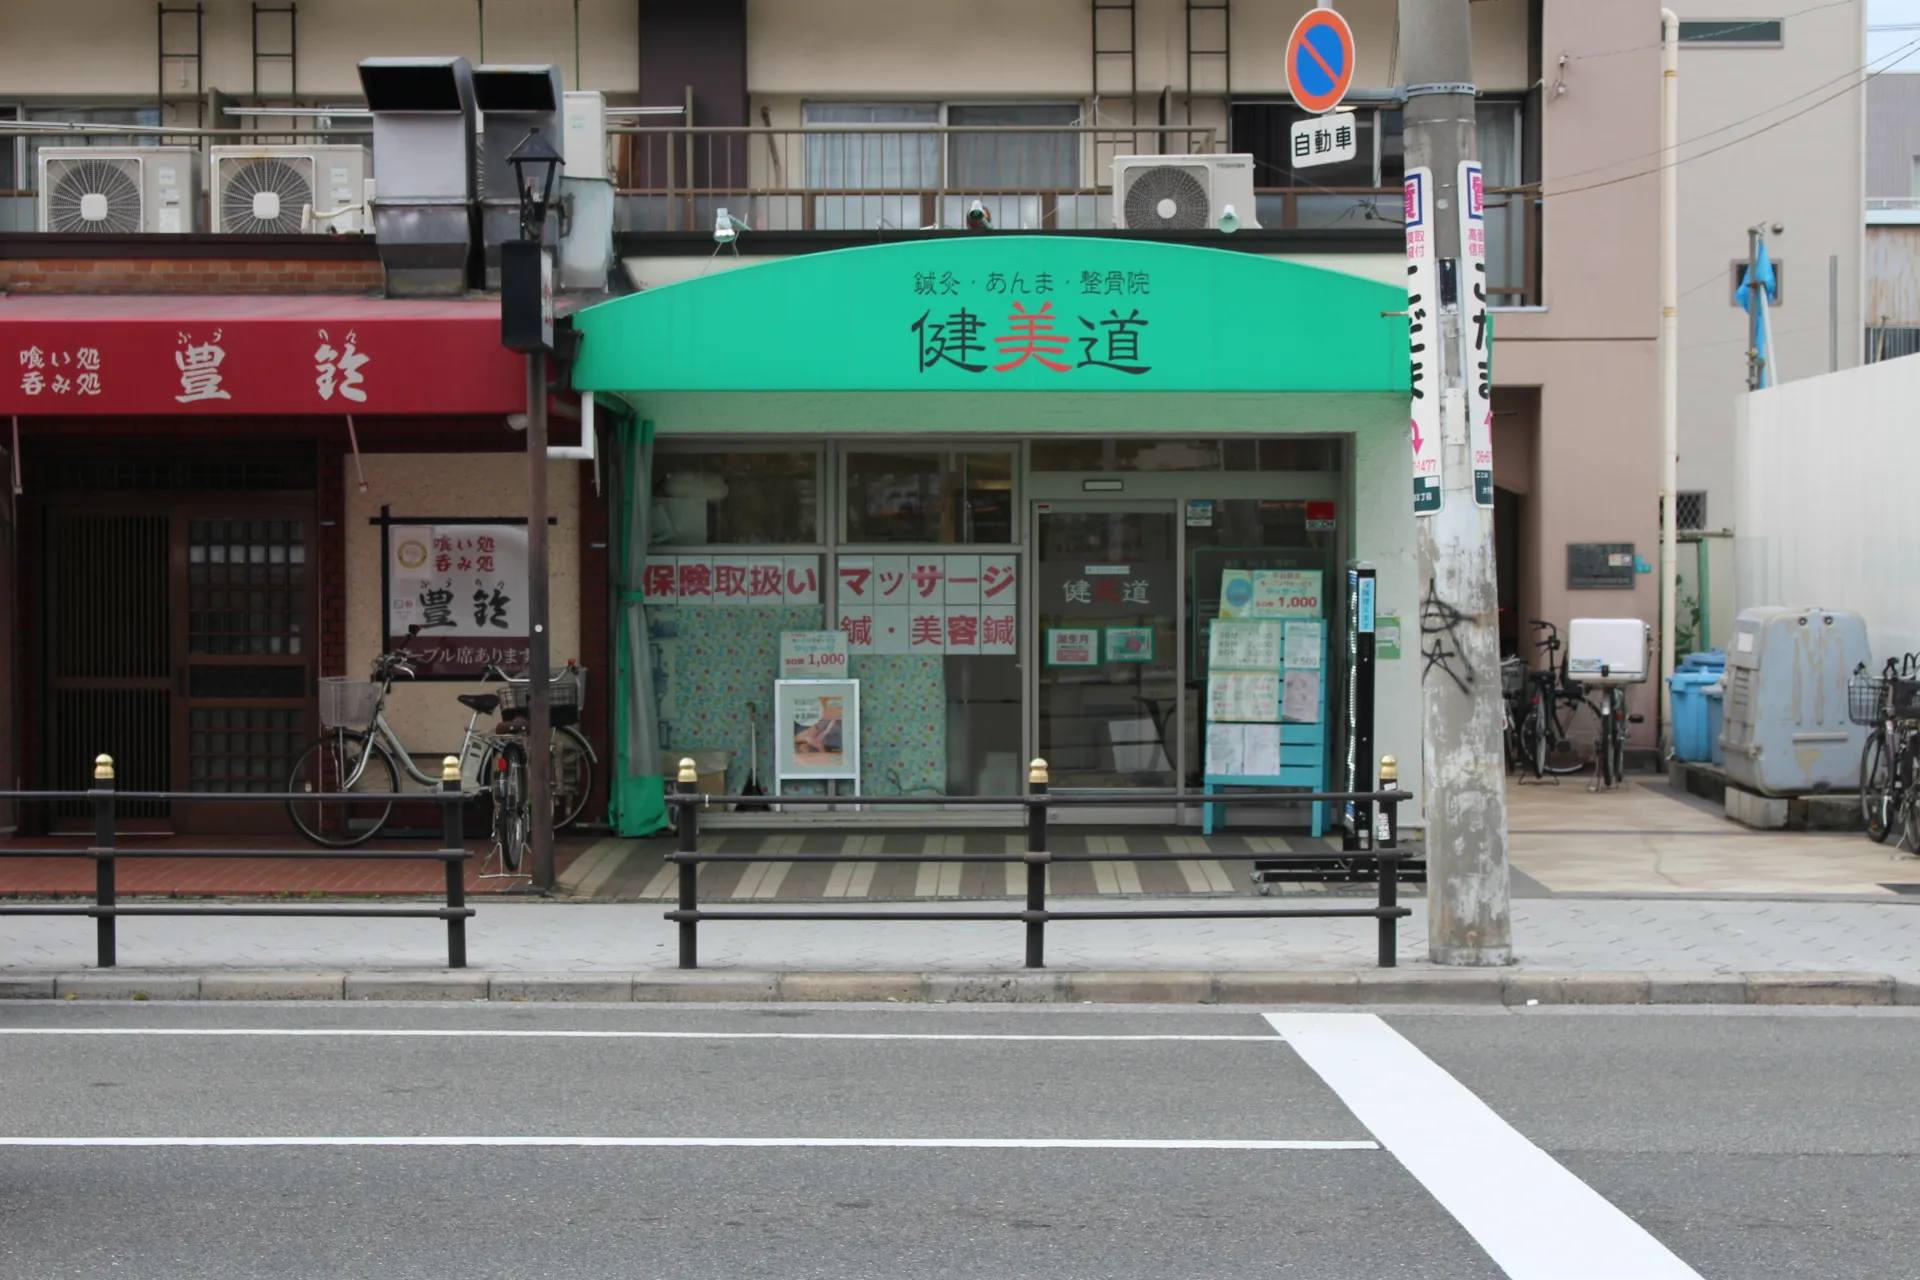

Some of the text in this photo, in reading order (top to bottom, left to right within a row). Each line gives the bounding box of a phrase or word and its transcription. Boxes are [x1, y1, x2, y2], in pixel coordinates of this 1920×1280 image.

[1294, 126, 1352, 157] 自動車
[914, 270, 1150, 296] 鍼灸・あんま・整骨院
[911, 301, 1152, 375] 健美道
[19, 345, 101, 370] 喰い処
[20, 371, 102, 395] 呑み処
[435, 554, 496, 573] 呑み処
[644, 564, 818, 598] 保険取扱い
[839, 564, 1015, 598] マッサージ
[1278, 596, 1318, 609] 1,000
[808, 653, 846, 667] 1,000
